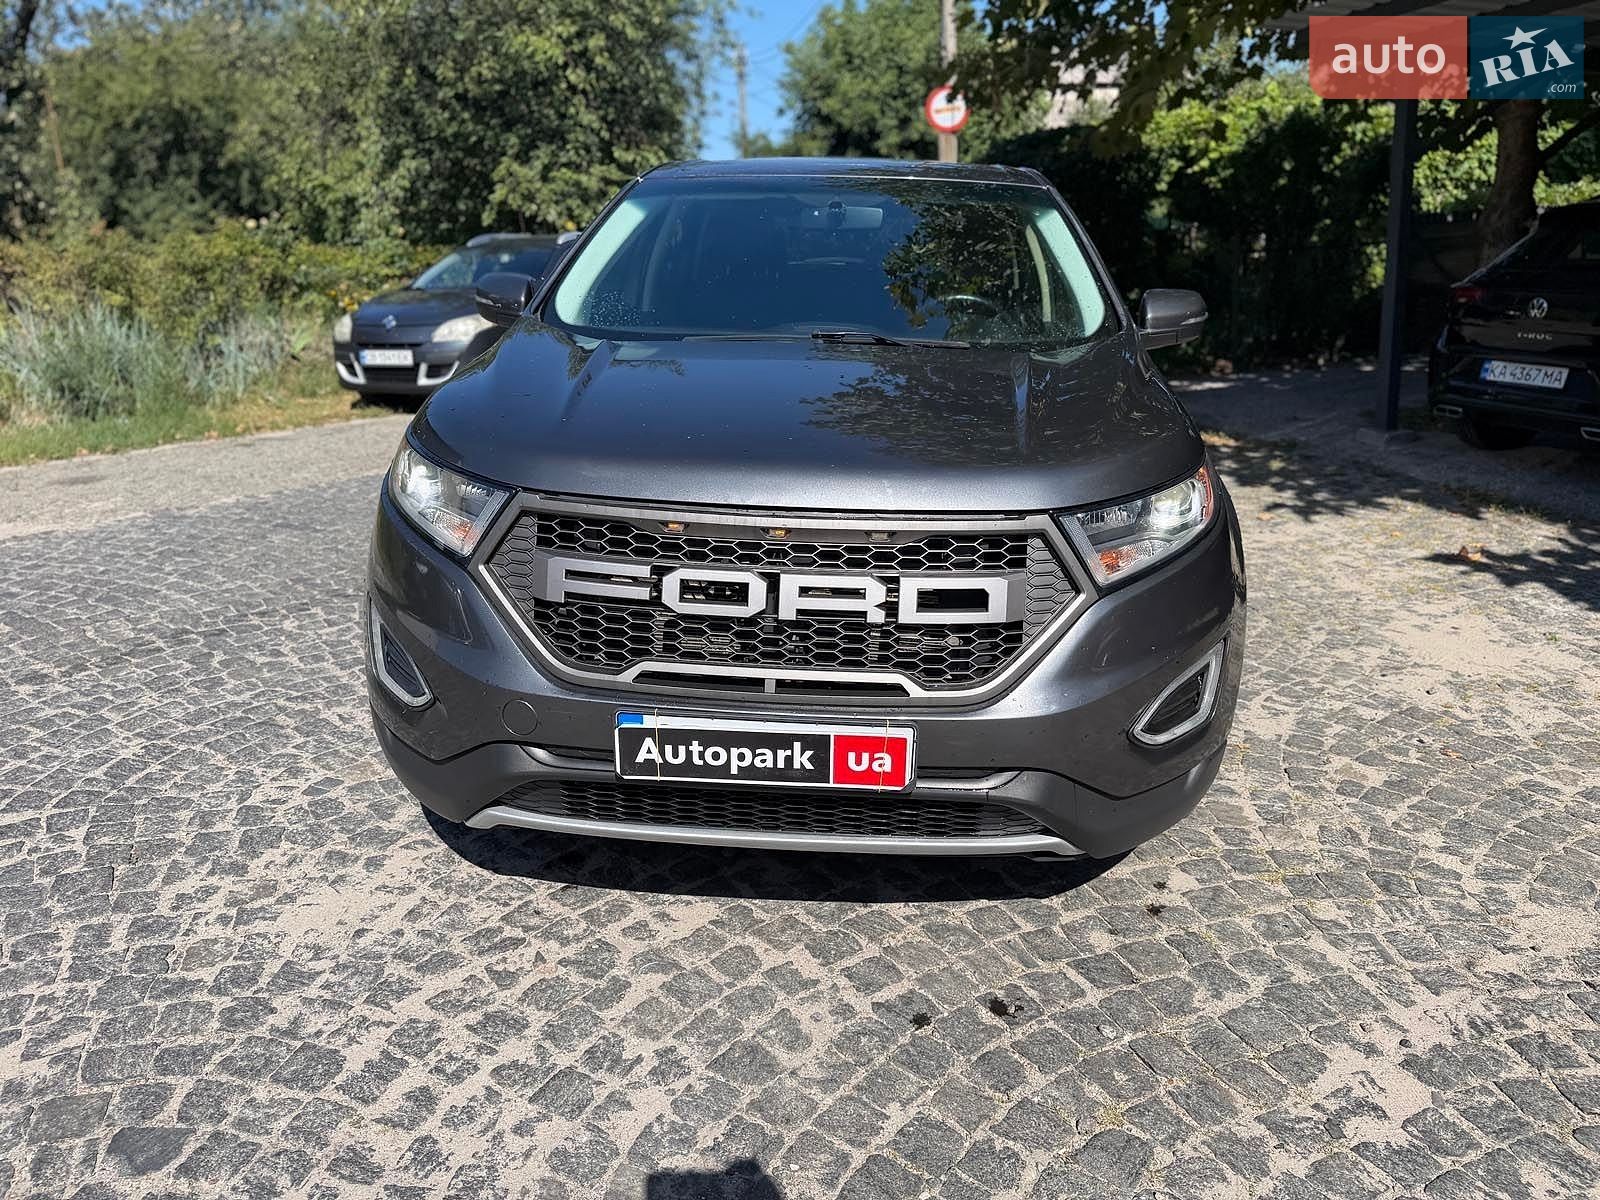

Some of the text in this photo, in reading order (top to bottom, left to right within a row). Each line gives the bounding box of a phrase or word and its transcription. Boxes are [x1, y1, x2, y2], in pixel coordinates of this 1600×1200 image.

[535, 550, 1024, 623] FORD
[635, 736, 893, 775] Autopark ua
